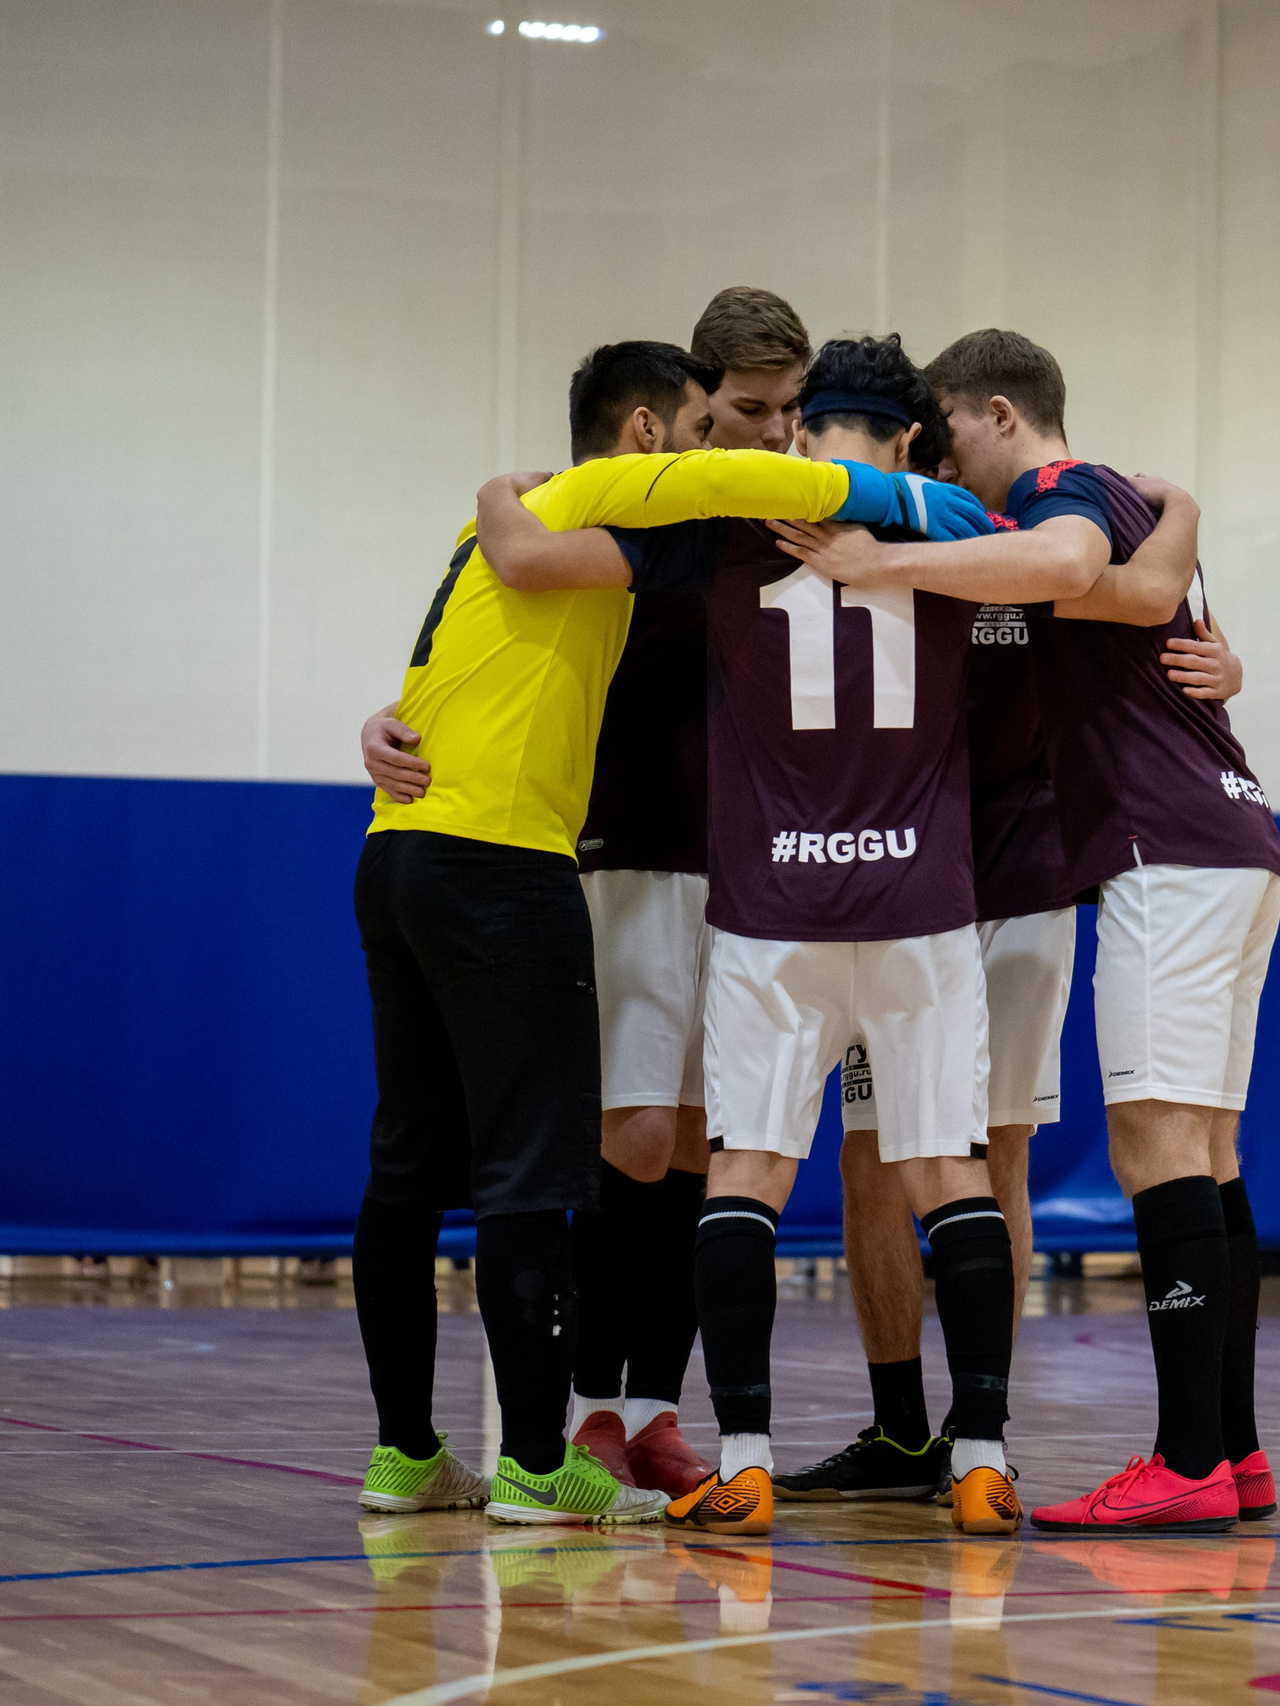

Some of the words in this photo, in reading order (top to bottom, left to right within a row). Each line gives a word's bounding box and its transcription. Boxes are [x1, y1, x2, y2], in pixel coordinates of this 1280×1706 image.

[759, 564, 915, 731] 11
[771, 827, 917, 864] #RGGU
[1148, 1294, 1207, 1312] DEMIX
